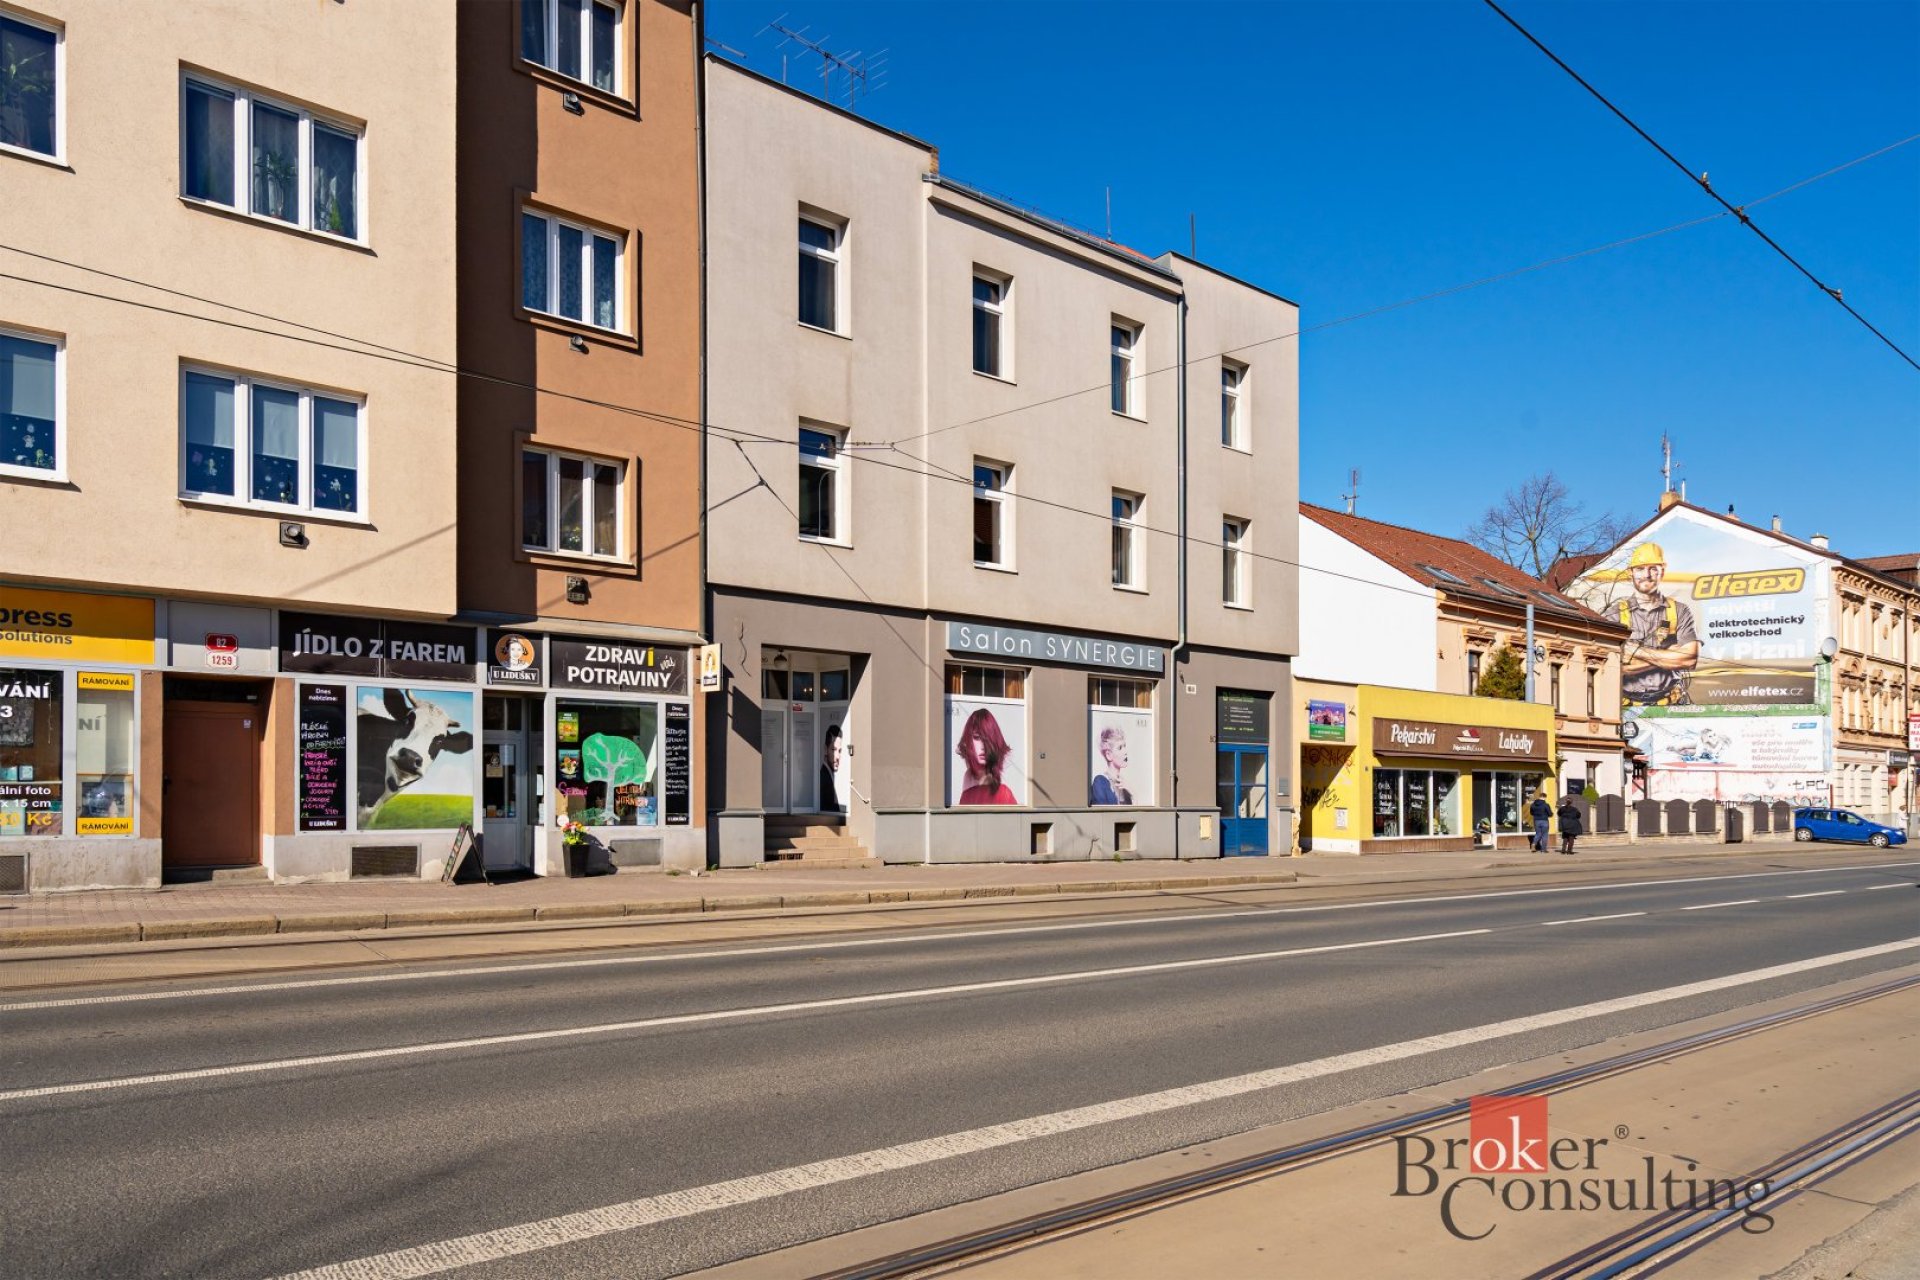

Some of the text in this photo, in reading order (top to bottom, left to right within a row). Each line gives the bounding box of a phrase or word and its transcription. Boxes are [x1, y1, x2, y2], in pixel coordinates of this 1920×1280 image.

[1693, 569, 1805, 599] Elfetex
[1709, 615, 1805, 629] elektrotechnický
[1709, 627, 1782, 639] velkoobchod
[292, 627, 466, 665] JÍDLO Z FAREM
[960, 626, 1156, 668] Salon SYNERGIE
[212, 655, 233, 666] 1259
[82, 676, 130, 686] RÁMOVÁNÍ
[493, 670, 537, 681] U LIDUŠKY
[567, 665, 671, 689] POTRAVINY
[1708, 686, 1804, 698] www.elfetex.cz
[1391, 723, 1436, 747] Pekařství
[1498, 732, 1534, 754] Lahůdky
[25, 785, 52, 795] foto
[1, 799, 52, 808] x 15 cm
[27, 811, 52, 827] Kč
